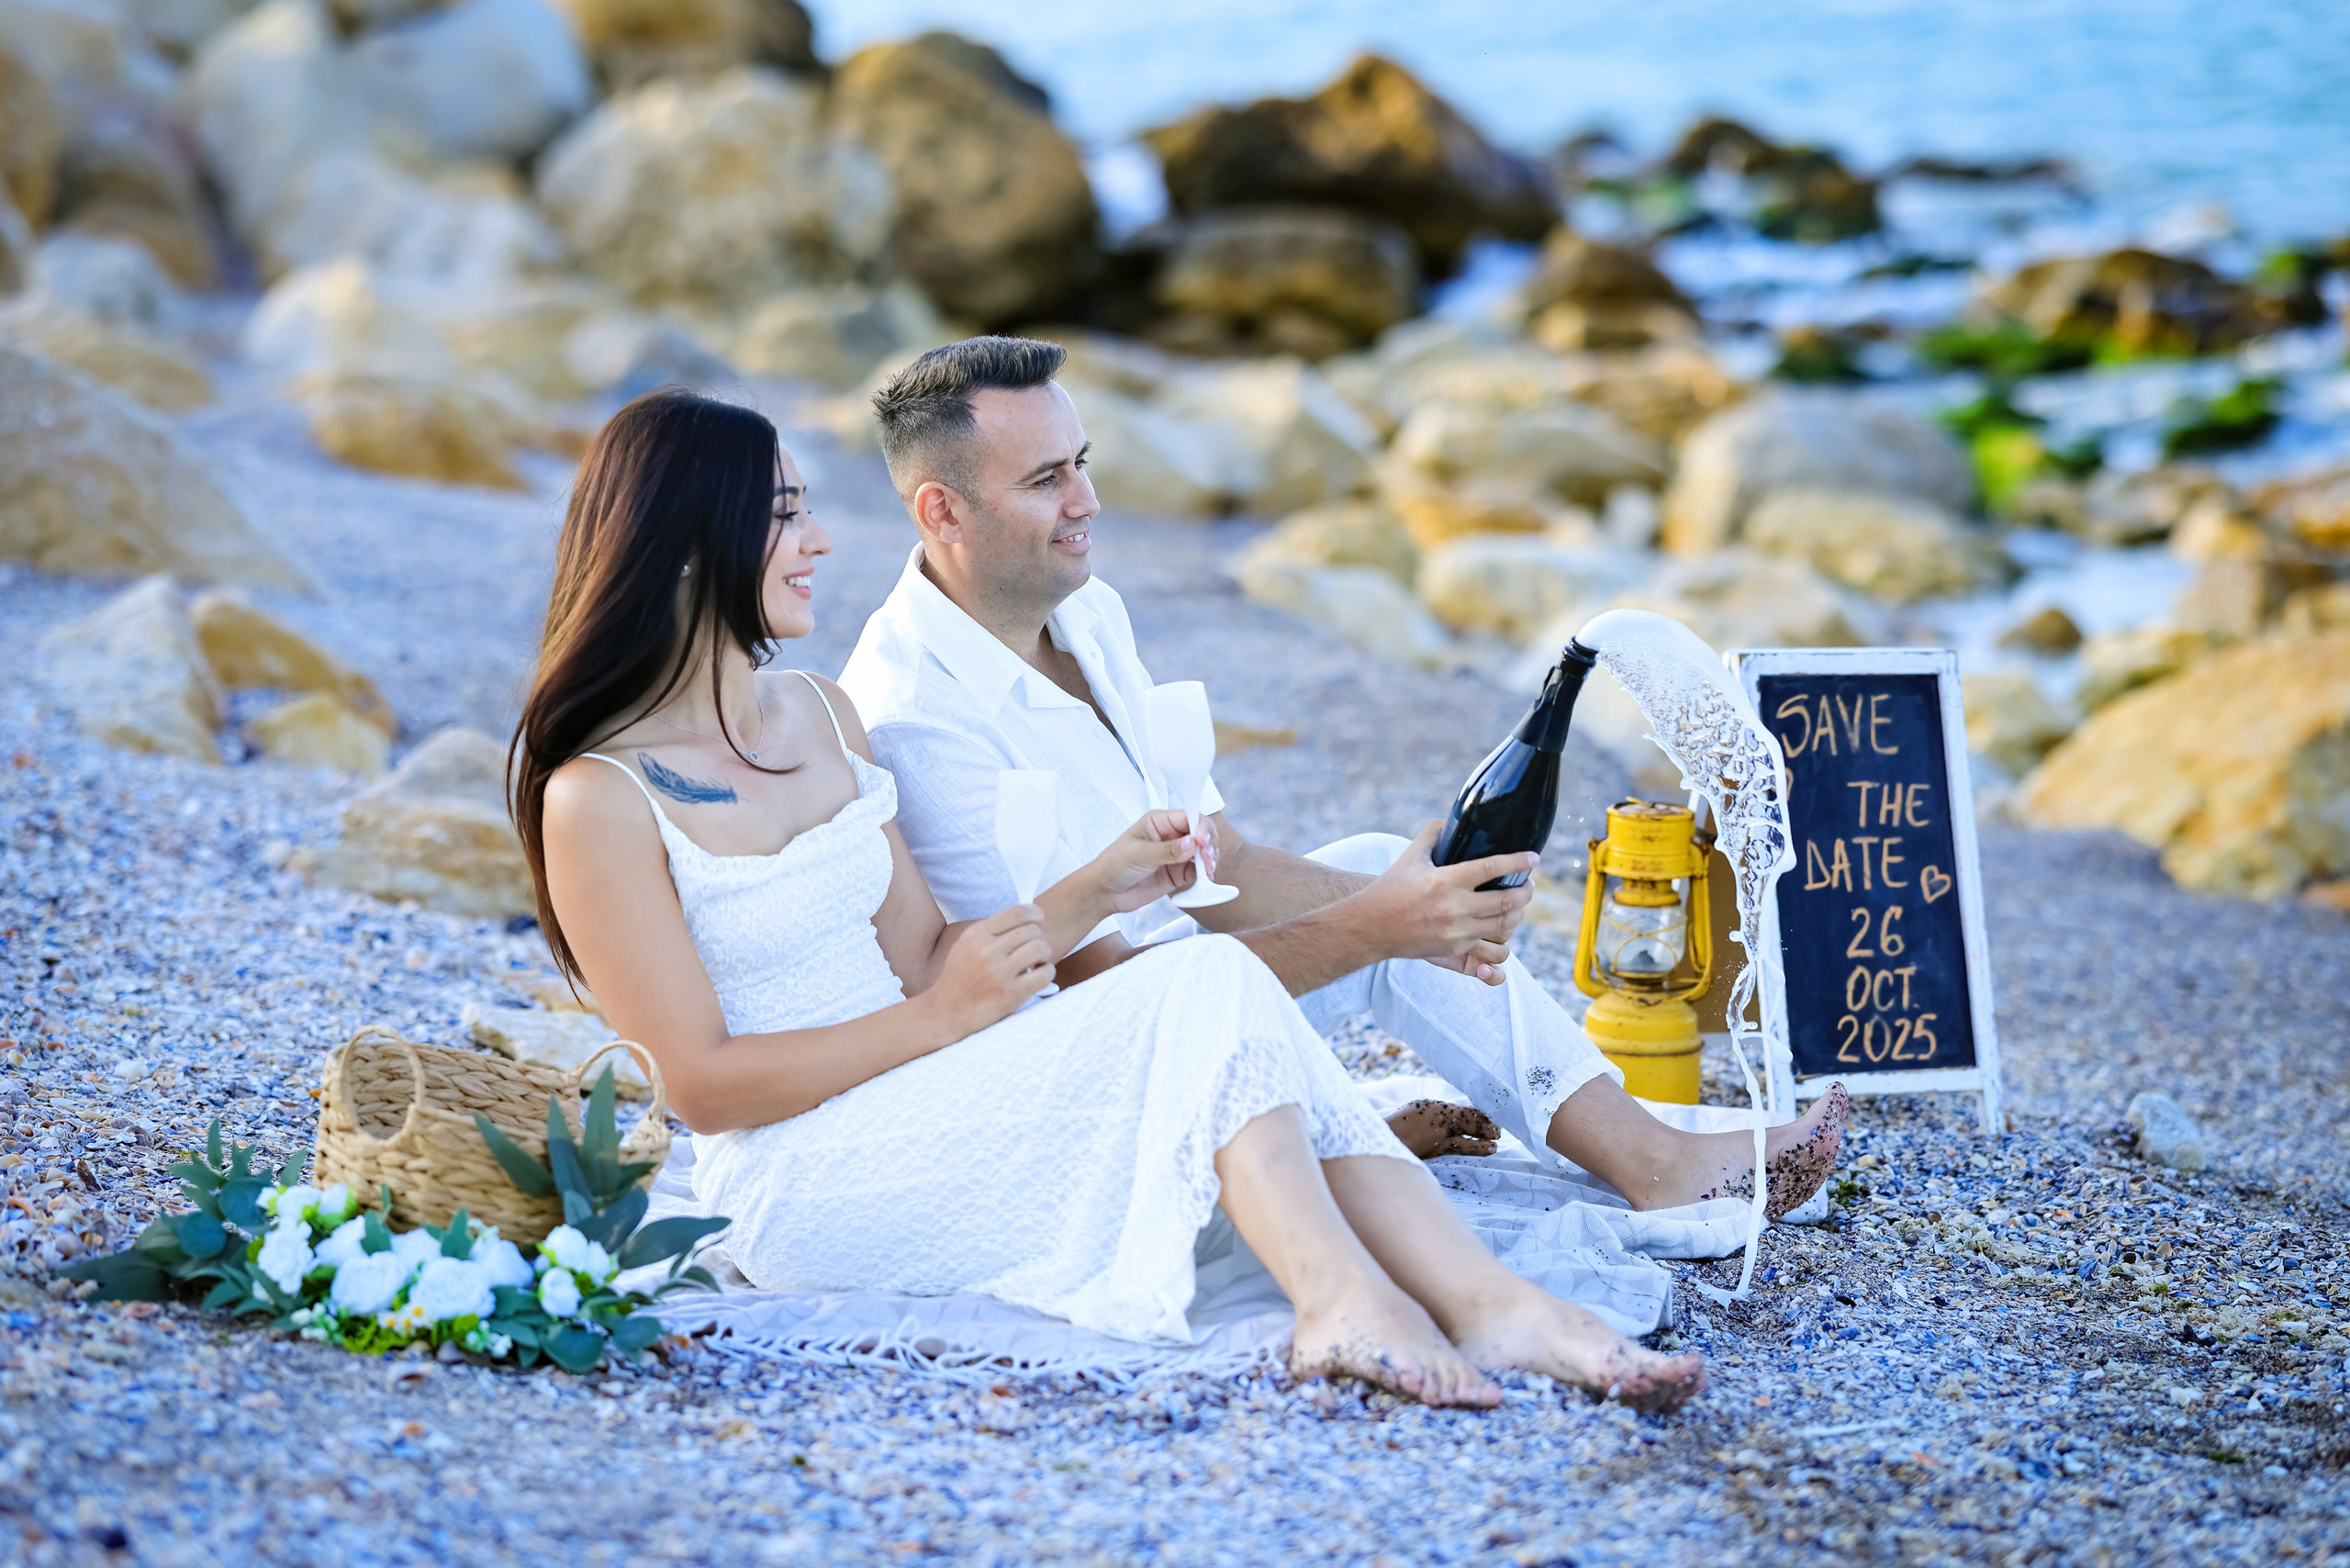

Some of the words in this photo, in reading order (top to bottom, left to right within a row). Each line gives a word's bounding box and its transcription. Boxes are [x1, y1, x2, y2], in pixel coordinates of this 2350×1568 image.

[1775, 694, 1899, 758] SAVE
[1847, 781, 1930, 828] THE
[1804, 836, 1908, 892] DATE
[1846, 905, 1905, 958] 26
[1837, 1014, 1938, 1062] 2025
